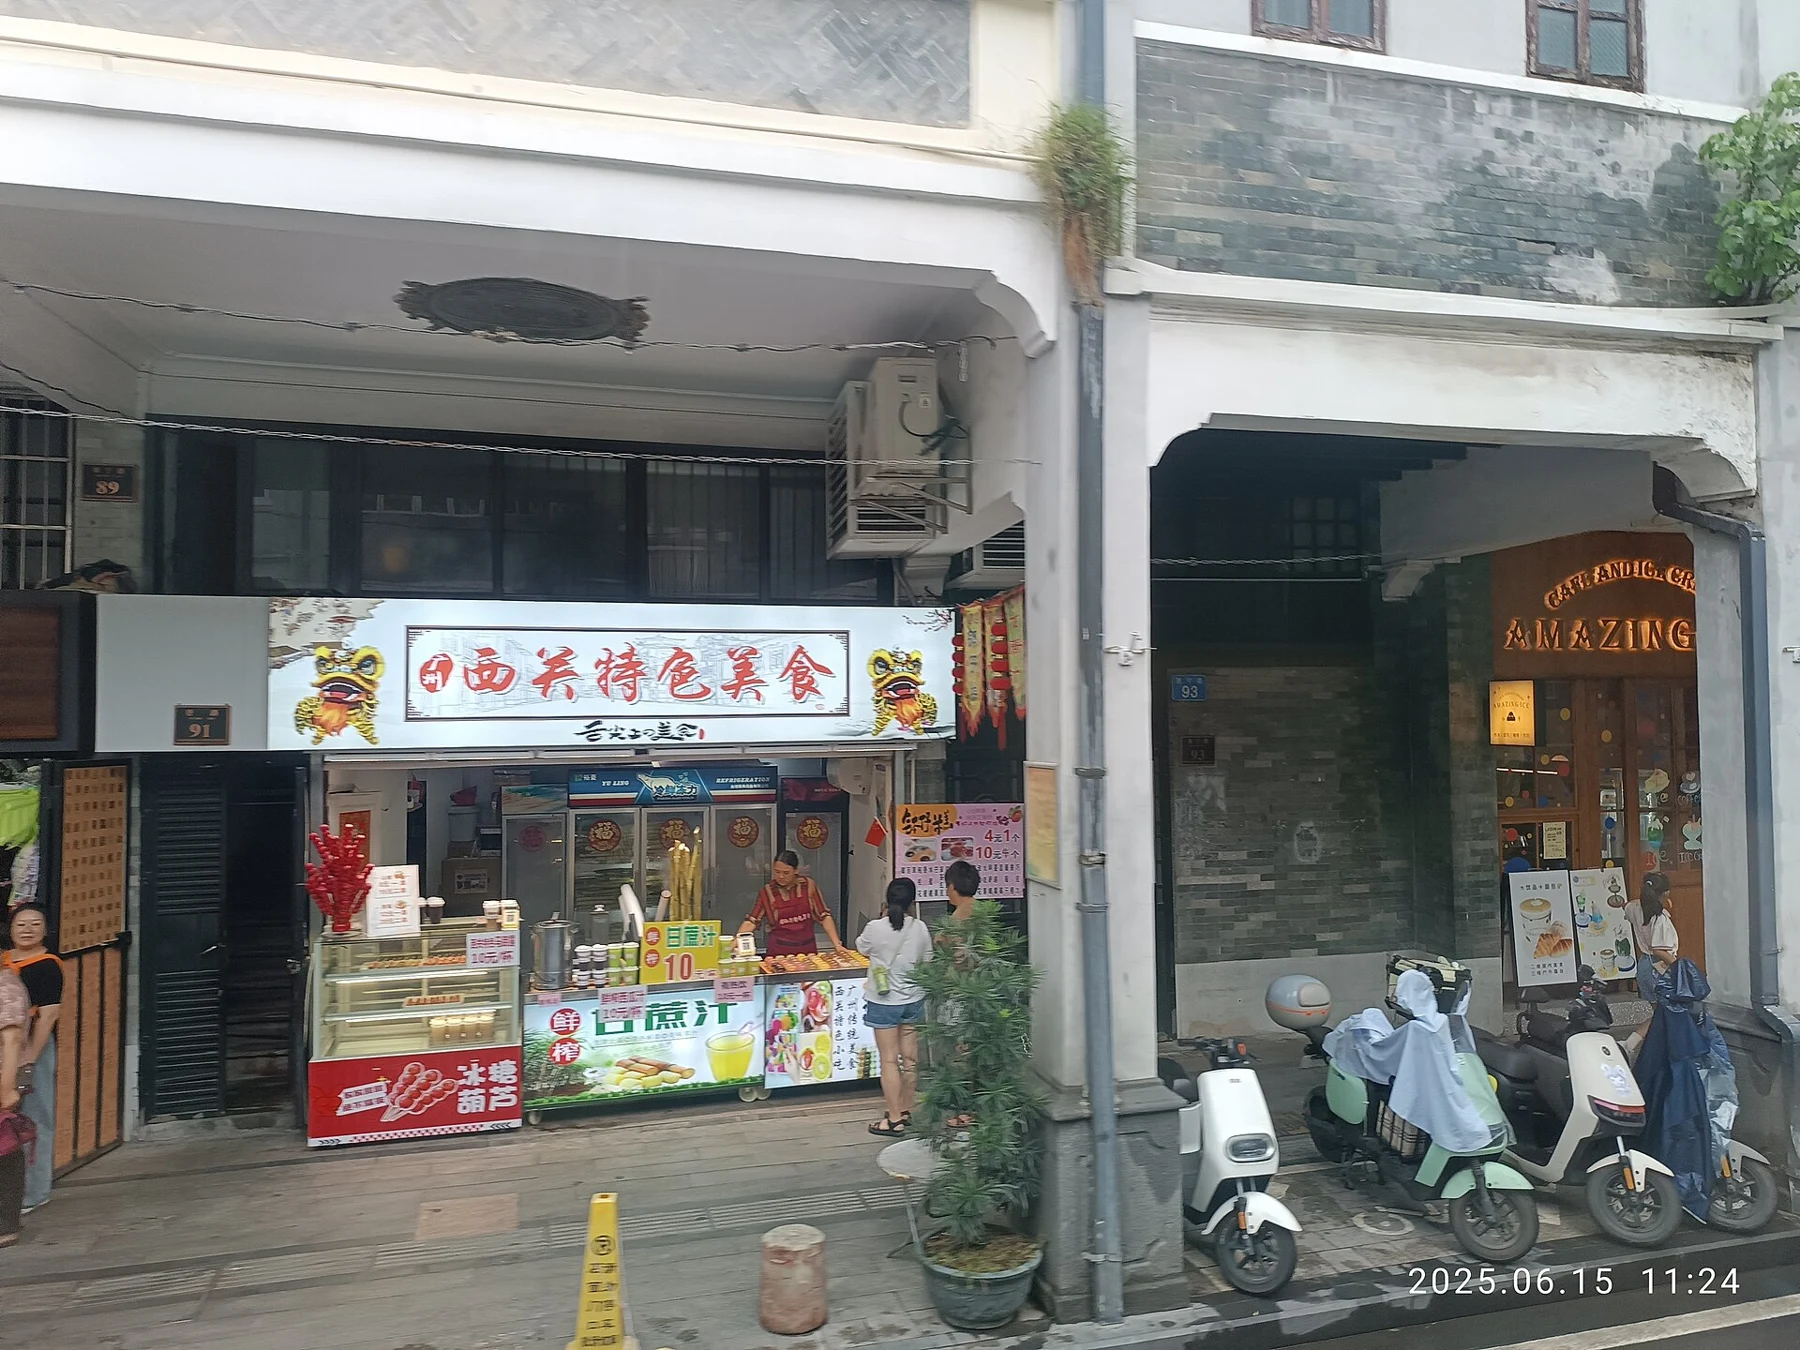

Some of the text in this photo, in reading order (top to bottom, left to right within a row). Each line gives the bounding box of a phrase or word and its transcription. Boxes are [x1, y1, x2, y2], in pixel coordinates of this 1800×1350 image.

[96, 480, 120, 495] 89
[1598, 561, 1634, 582] AND
[1671, 566, 1695, 591] CR
[1504, 619, 1695, 651] AMAZING
[421, 653, 450, 692] 广州
[463, 641, 836, 704] 西关特色美食
[1181, 685, 1198, 698] 93
[188, 723, 211, 738] 91
[1190, 750, 1205, 761] 93
[984, 829, 1020, 843] 4元1个
[552, 1012, 580, 1062] 鲜榨
[457, 1059, 518, 1087] 冰糖
[456, 1085, 518, 1114] 葫芦
